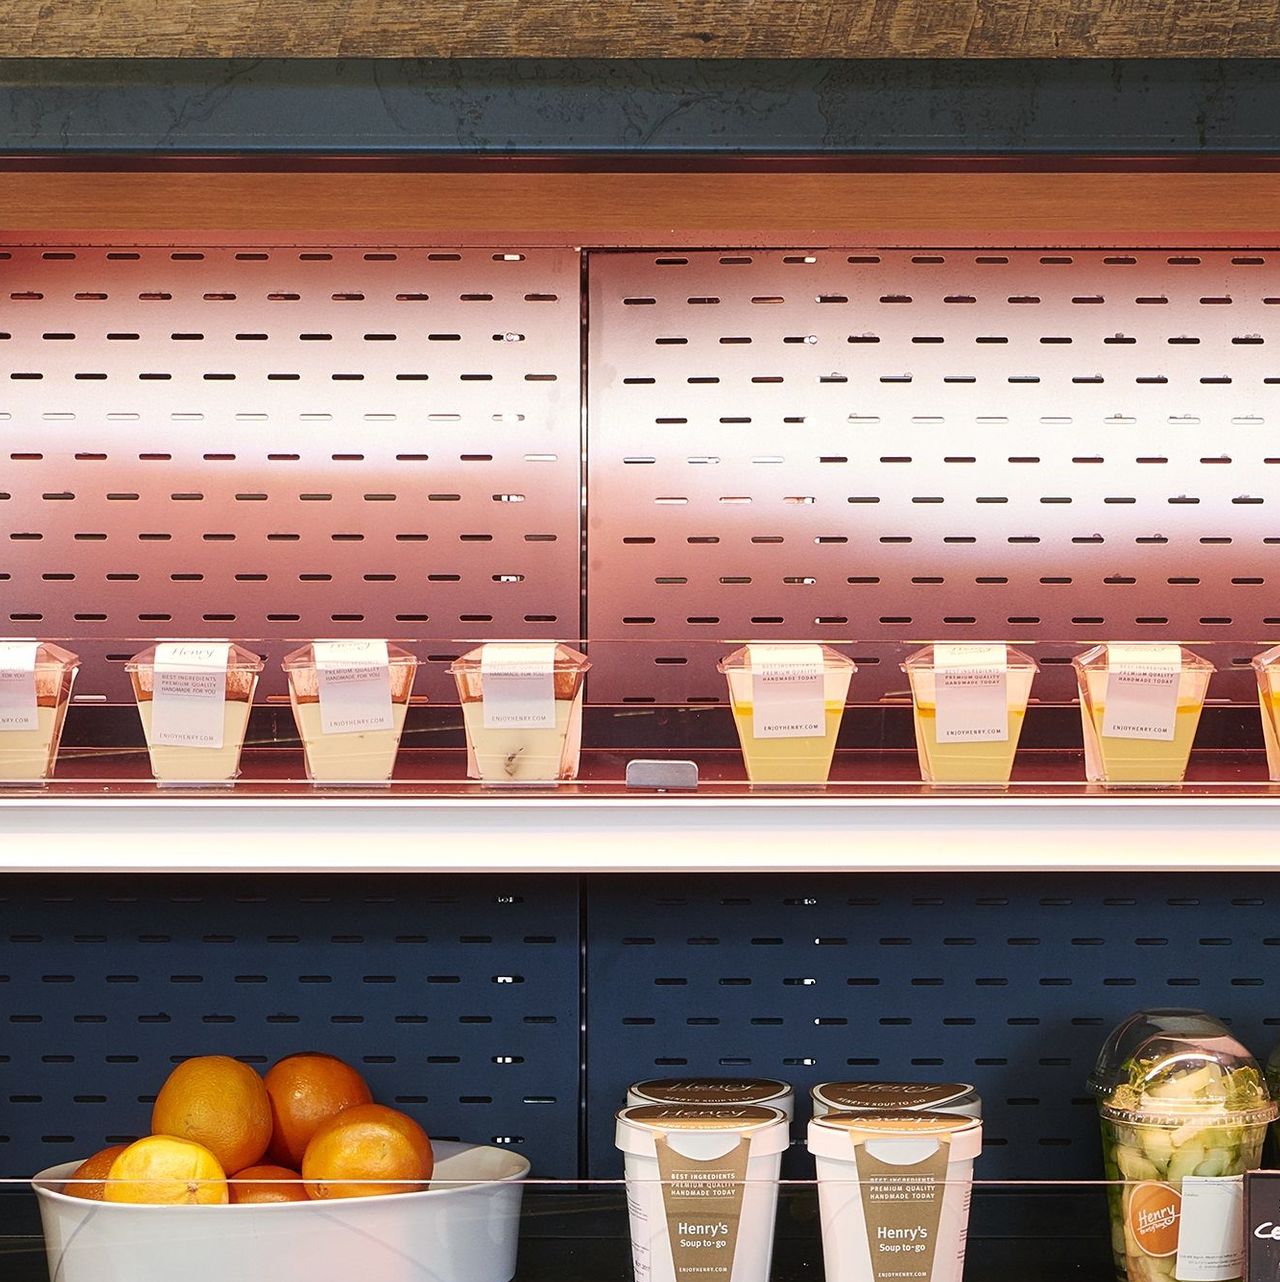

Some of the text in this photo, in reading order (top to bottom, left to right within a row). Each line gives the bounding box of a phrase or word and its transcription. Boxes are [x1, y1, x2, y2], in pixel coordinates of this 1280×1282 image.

[329, 718, 384, 727] ENJOYHENRY.COM
[1112, 725, 1168, 733] ENJOYHENRY.COM
[159, 732, 214, 741] ENJOYHENRY.COM
[1138, 1204, 1176, 1227] Henry
[678, 1222, 728, 1238] Henry's
[877, 1226, 928, 1241] Henry's
[680, 1239, 702, 1249] Soup
[879, 1243, 901, 1253] Soup
